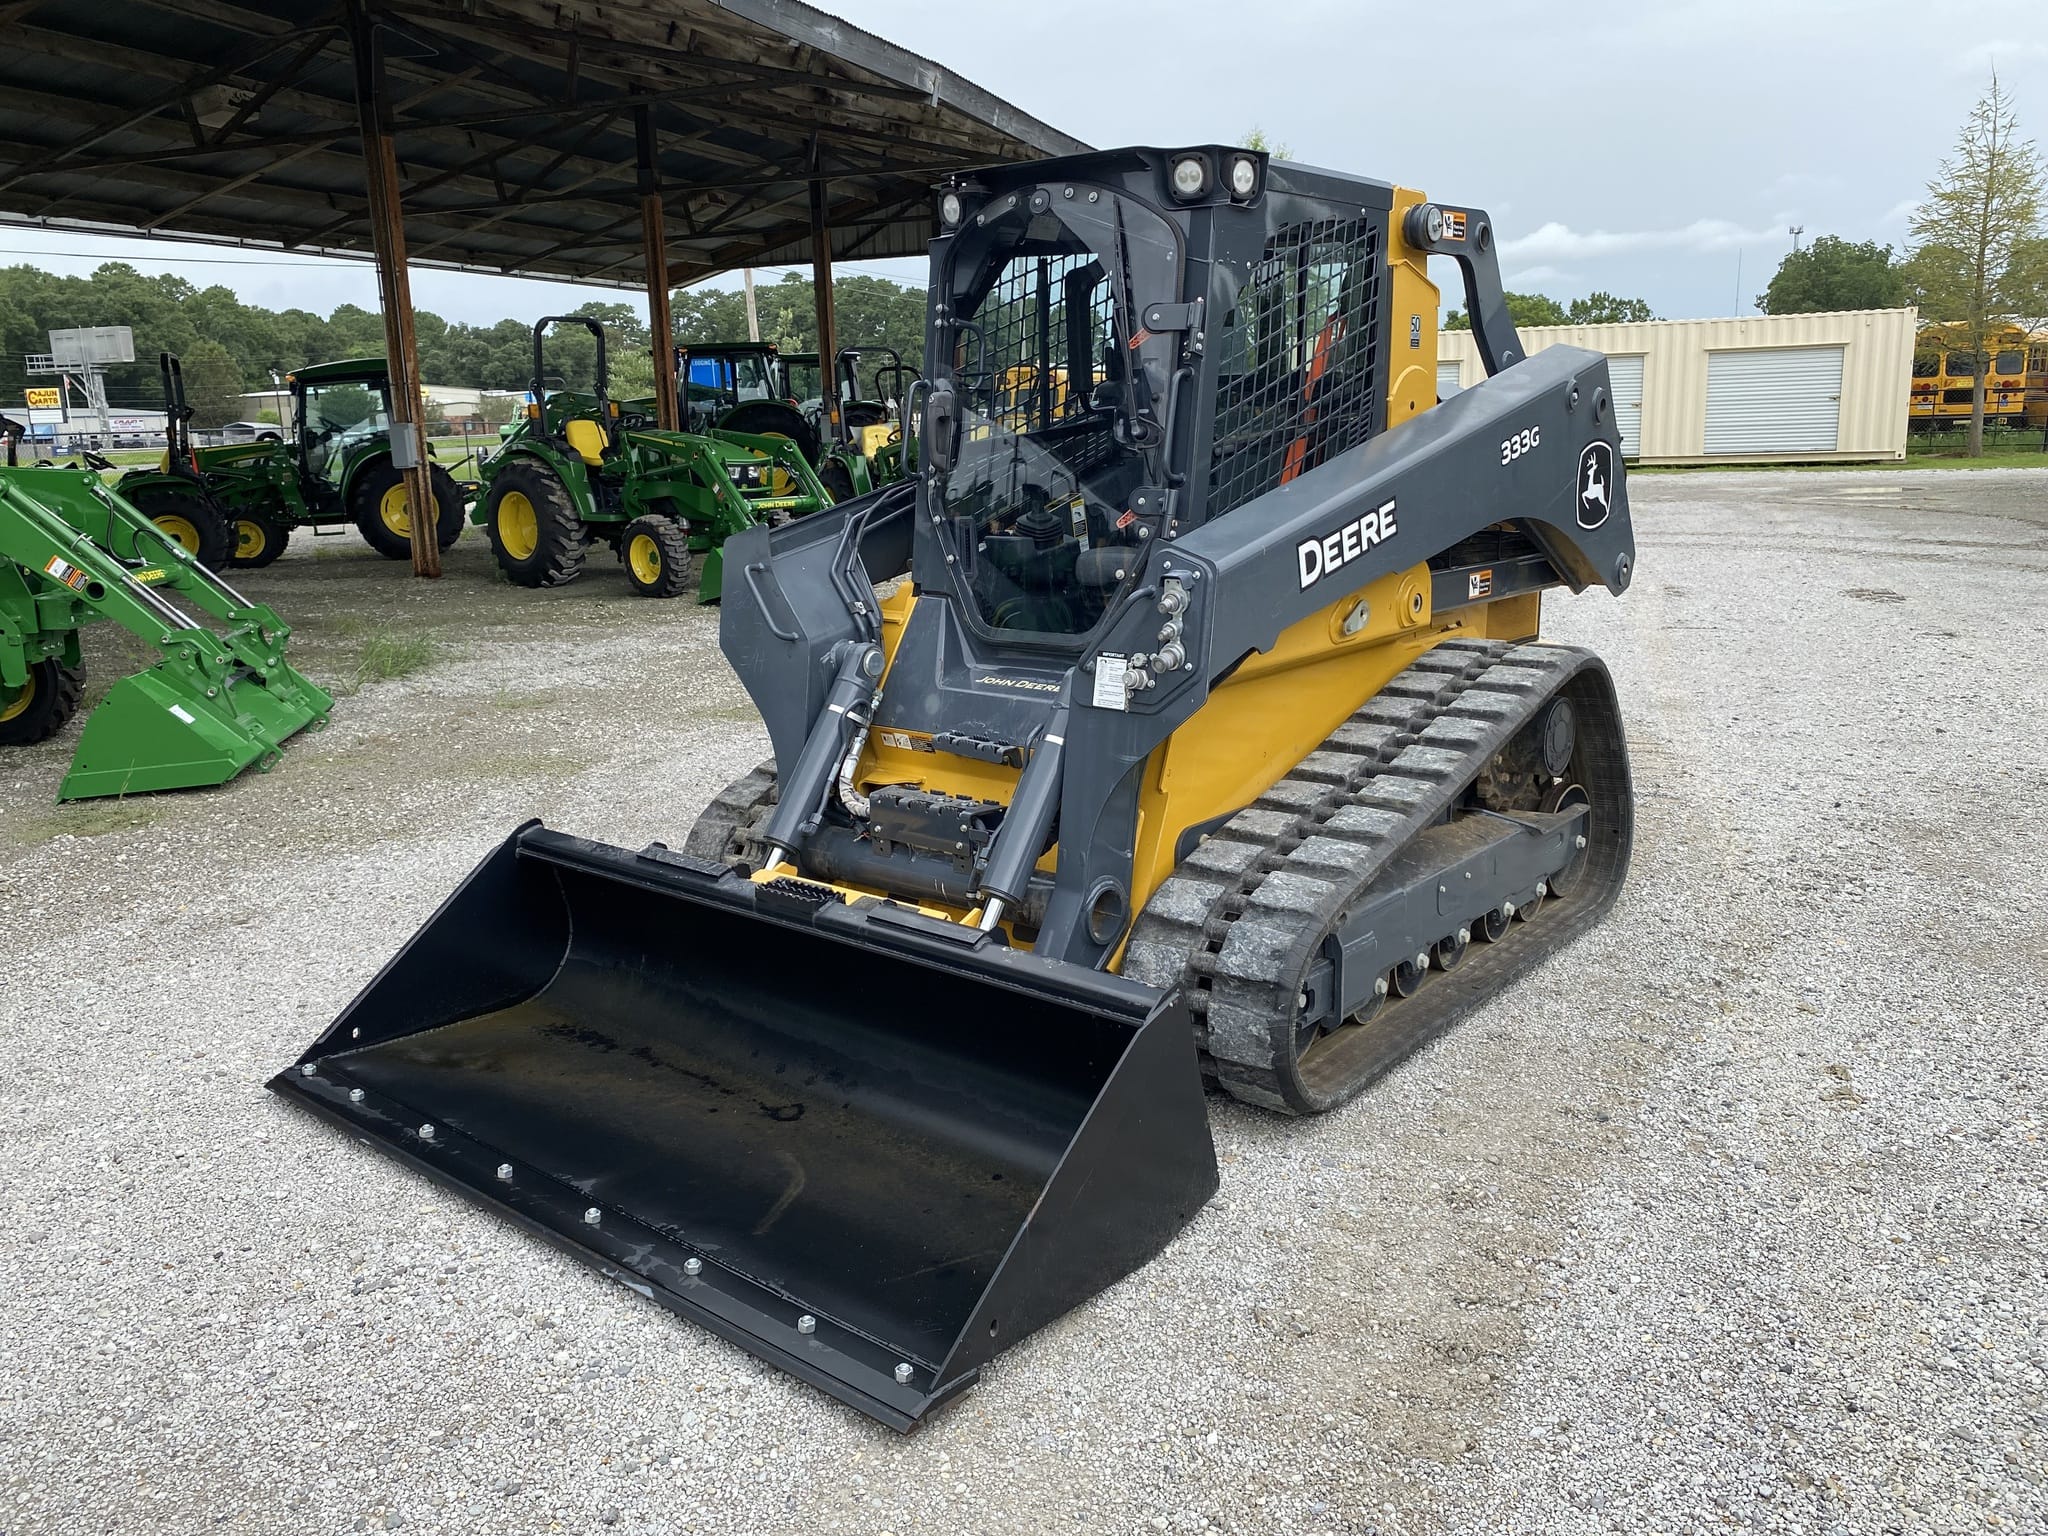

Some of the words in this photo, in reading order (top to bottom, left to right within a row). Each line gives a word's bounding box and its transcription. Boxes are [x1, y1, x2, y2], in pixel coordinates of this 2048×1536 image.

[1411, 316, 1420, 333] 50
[28, 390, 57, 401] CAJUN
[1501, 426, 1540, 466] 333G
[757, 501, 774, 509] JOHN
[775, 500, 796, 508] DEERE
[1298, 499, 1397, 590] DEERE
[976, 676, 1016, 687] JOHN
